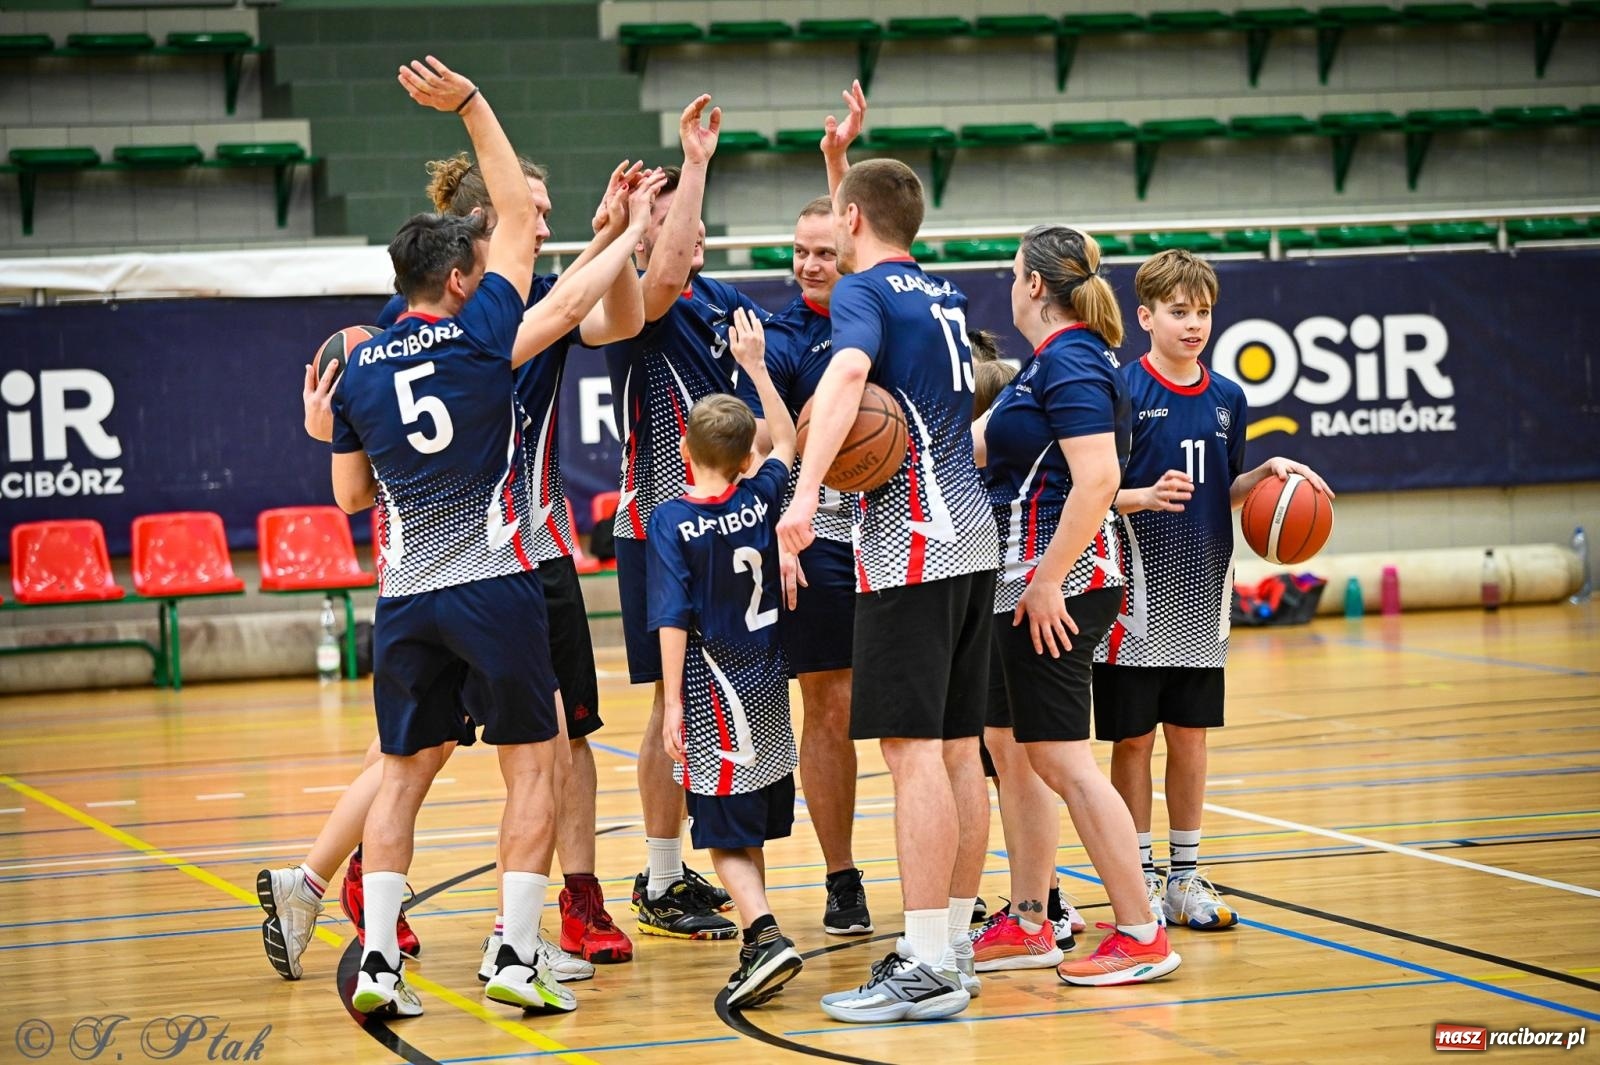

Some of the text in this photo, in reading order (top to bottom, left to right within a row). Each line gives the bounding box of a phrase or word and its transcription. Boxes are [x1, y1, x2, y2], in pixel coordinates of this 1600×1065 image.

[358, 322, 464, 367] RACIBÓRZ
[1212, 315, 1455, 407] OSiR
[394, 361, 454, 454] 5
[1311, 400, 1456, 437] RACIBÓRZ
[0, 461, 125, 499] CIBÓRZ
[1180, 439, 1205, 484] 11
[733, 546, 778, 632] 2
